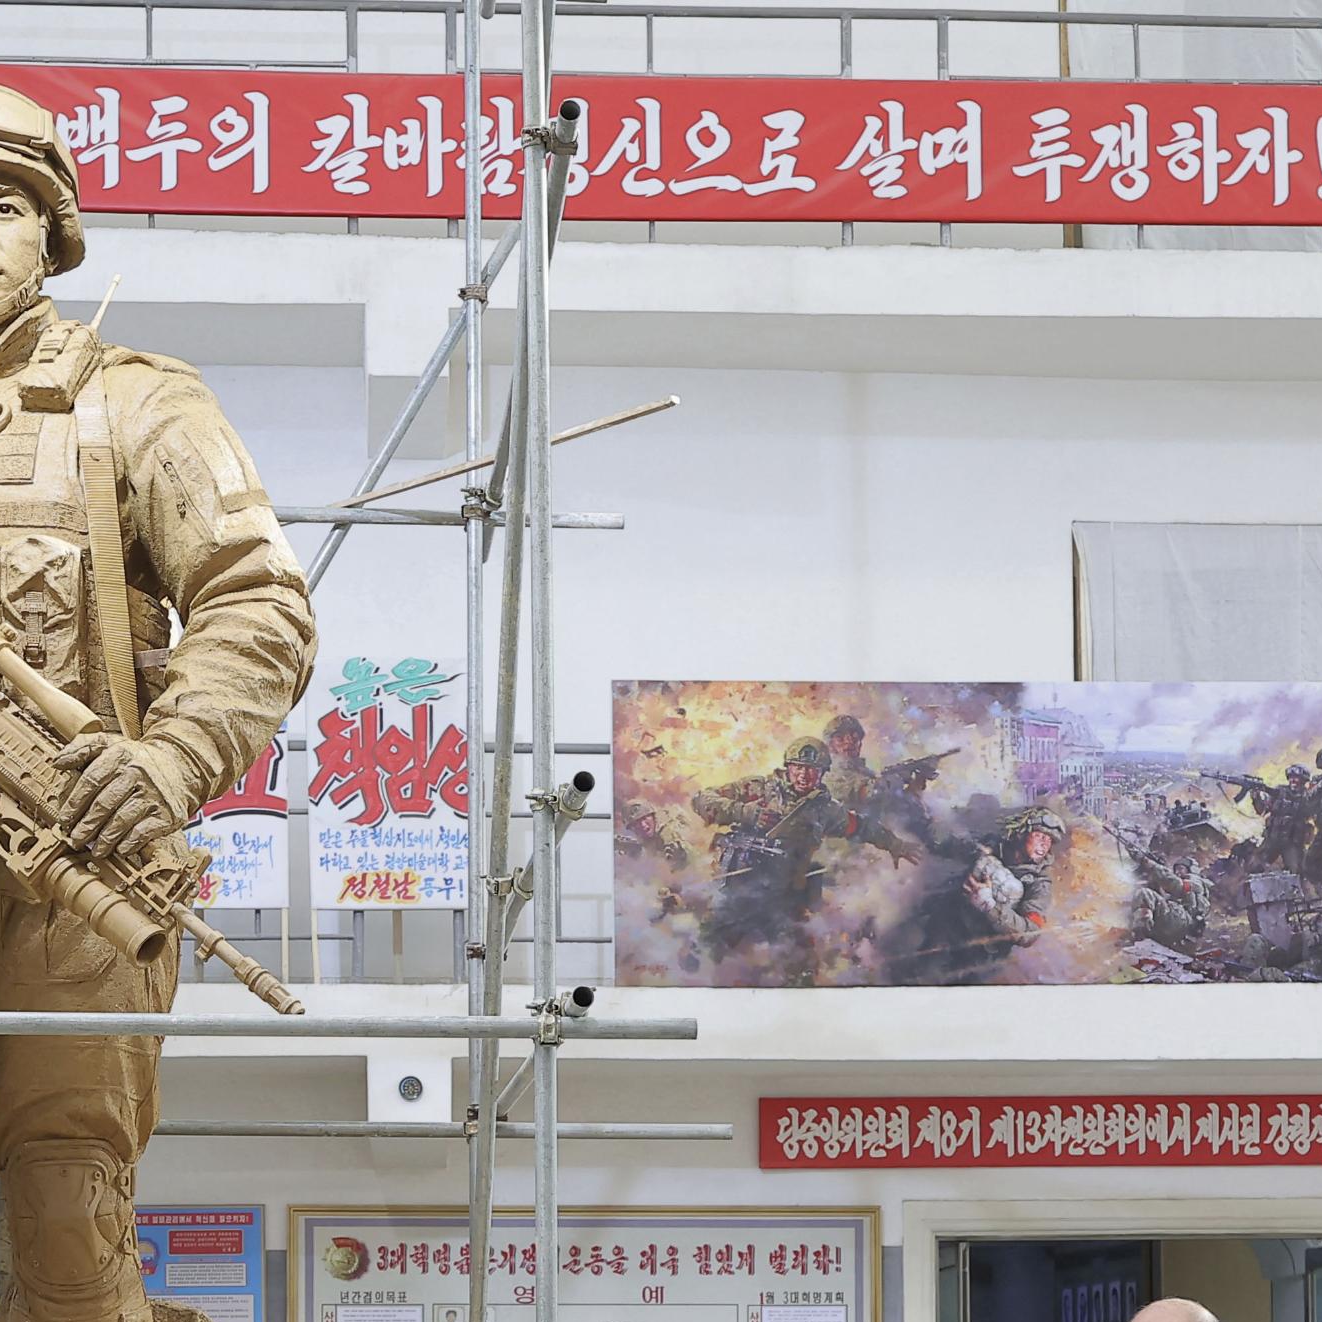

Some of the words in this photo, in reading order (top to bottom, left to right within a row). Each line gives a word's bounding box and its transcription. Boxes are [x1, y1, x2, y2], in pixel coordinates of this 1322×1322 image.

[55, 86, 270, 194] 백두의
[836, 98, 982, 201] 살며
[329, 656, 455, 712] 높은
[419, 877, 464, 900] 동무!
[776, 1105, 910, 1160] 당중앙위원회
[914, 1105, 981, 1158] 제8기
[1194, 1102, 1262, 1157] 제시된
[376, 1242, 629, 1276] 3대혁명붉기쟁운동을
[692, 1243, 756, 1277] 힘있게
[768, 1243, 843, 1277] 벌리자!
